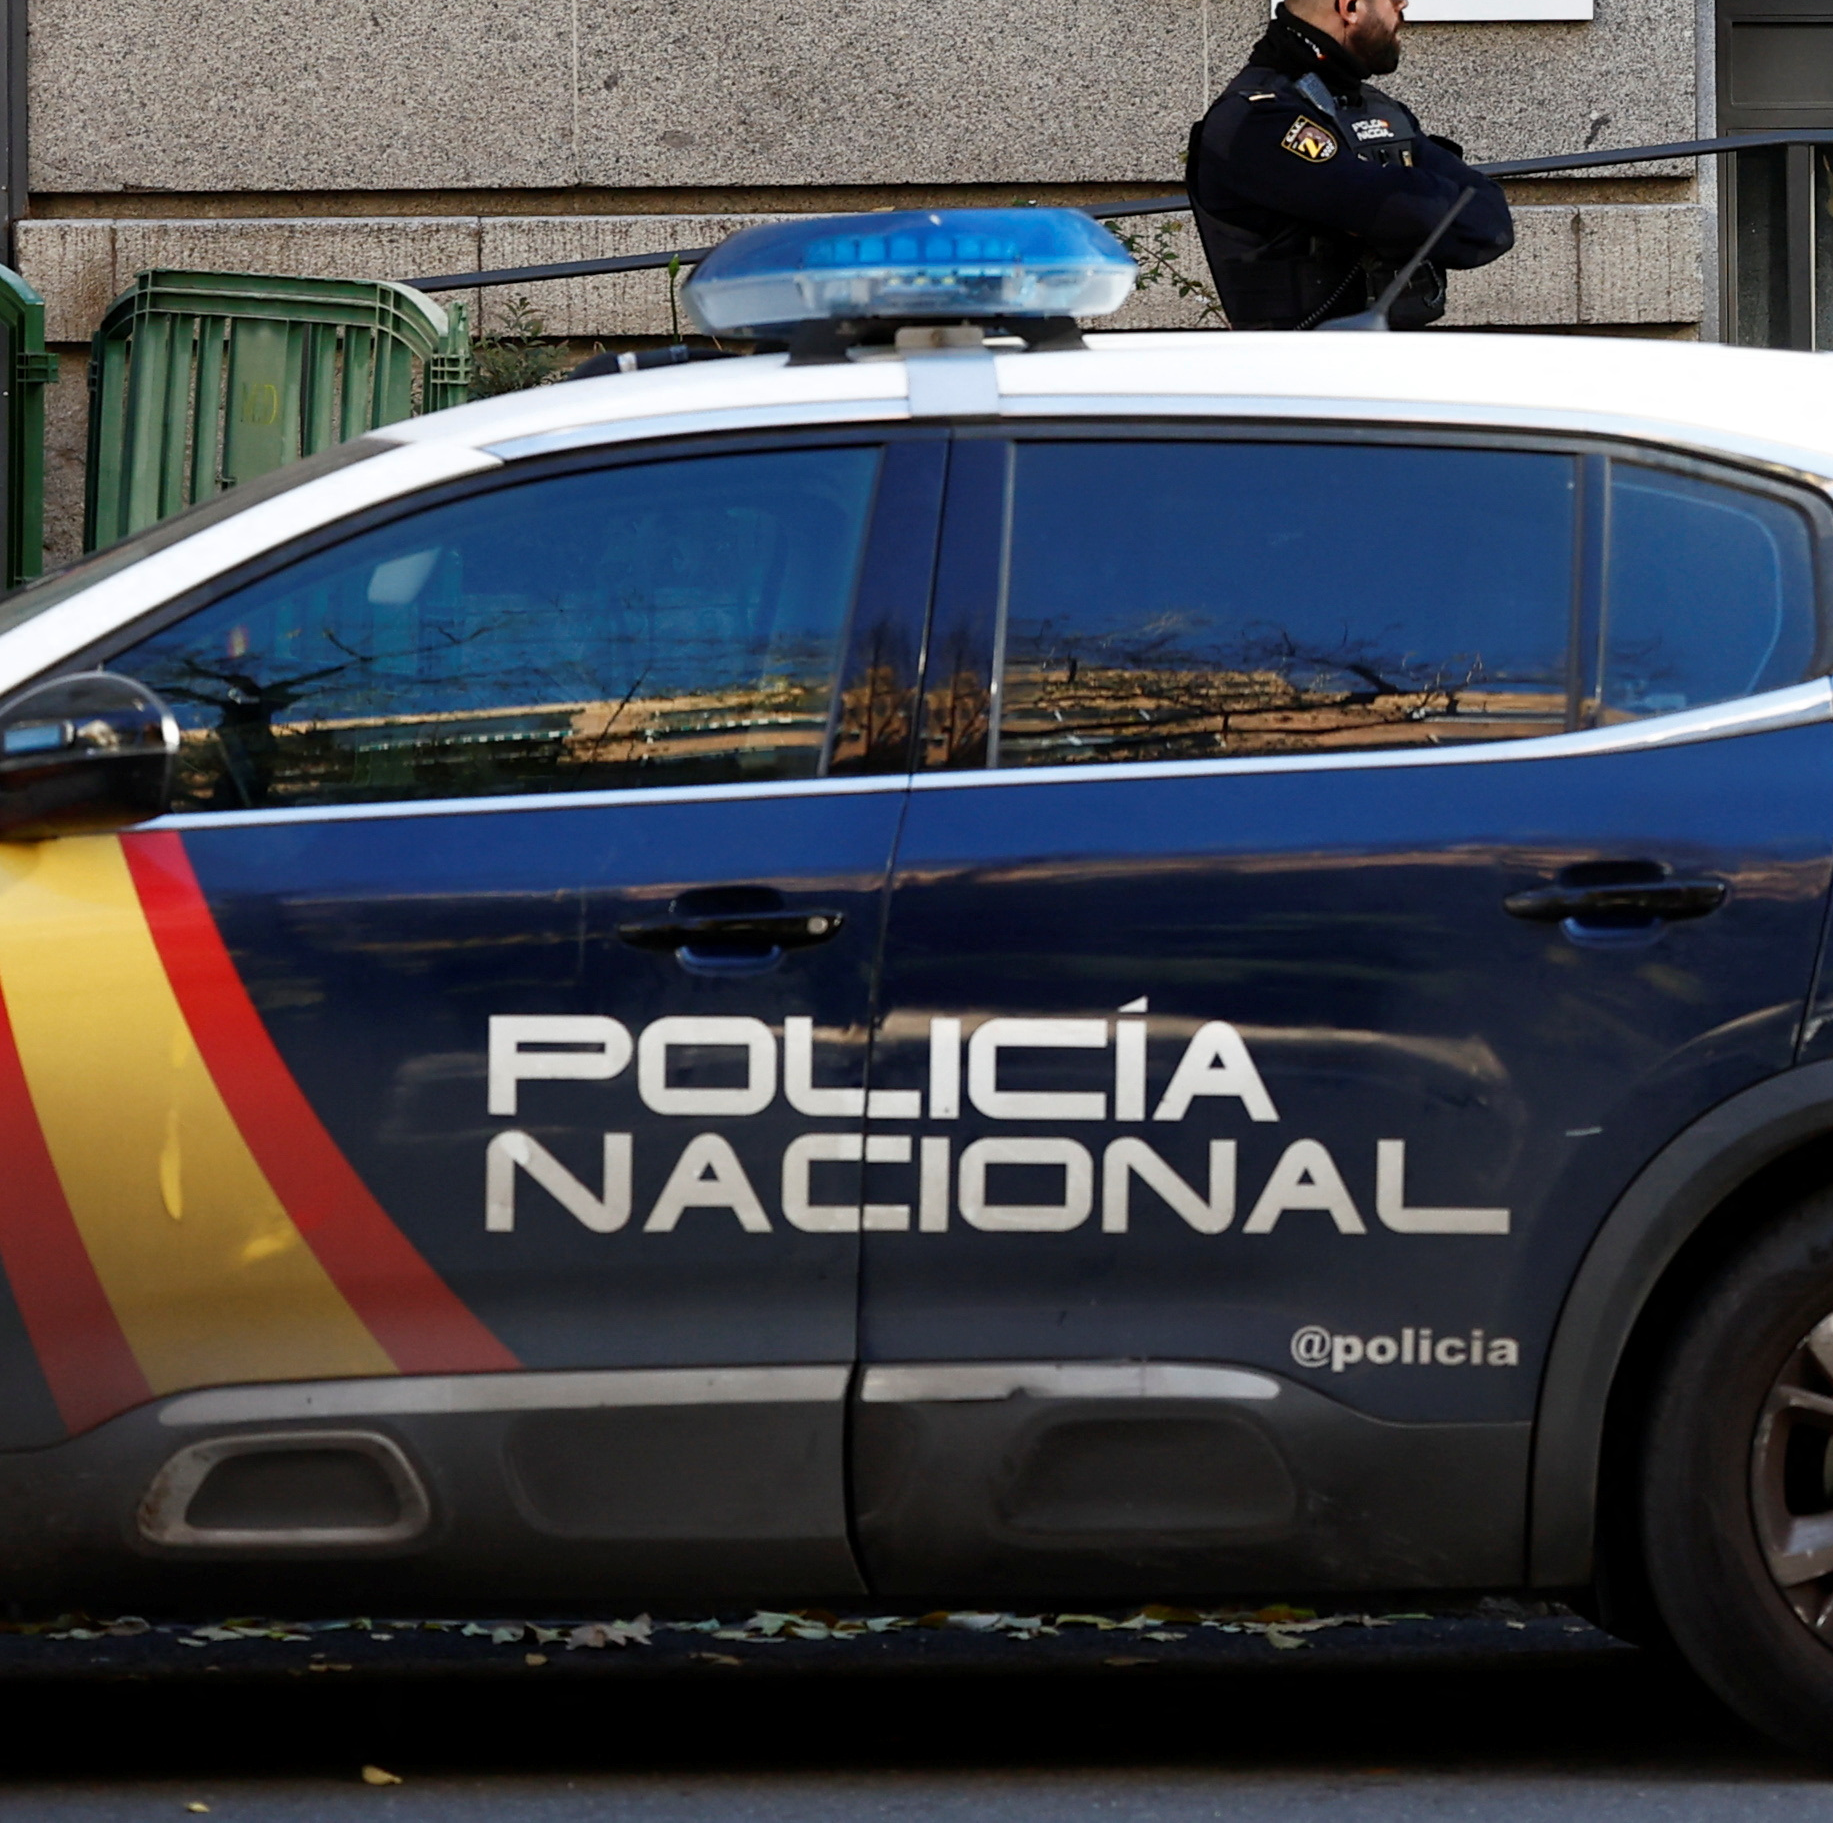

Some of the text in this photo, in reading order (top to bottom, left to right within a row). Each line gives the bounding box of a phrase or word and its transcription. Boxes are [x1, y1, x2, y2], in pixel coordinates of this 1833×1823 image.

[487, 994, 1281, 1123] POLICÍA
[485, 1129, 1511, 1236] NACIONAL
[1290, 1324, 1520, 1371] @policia
